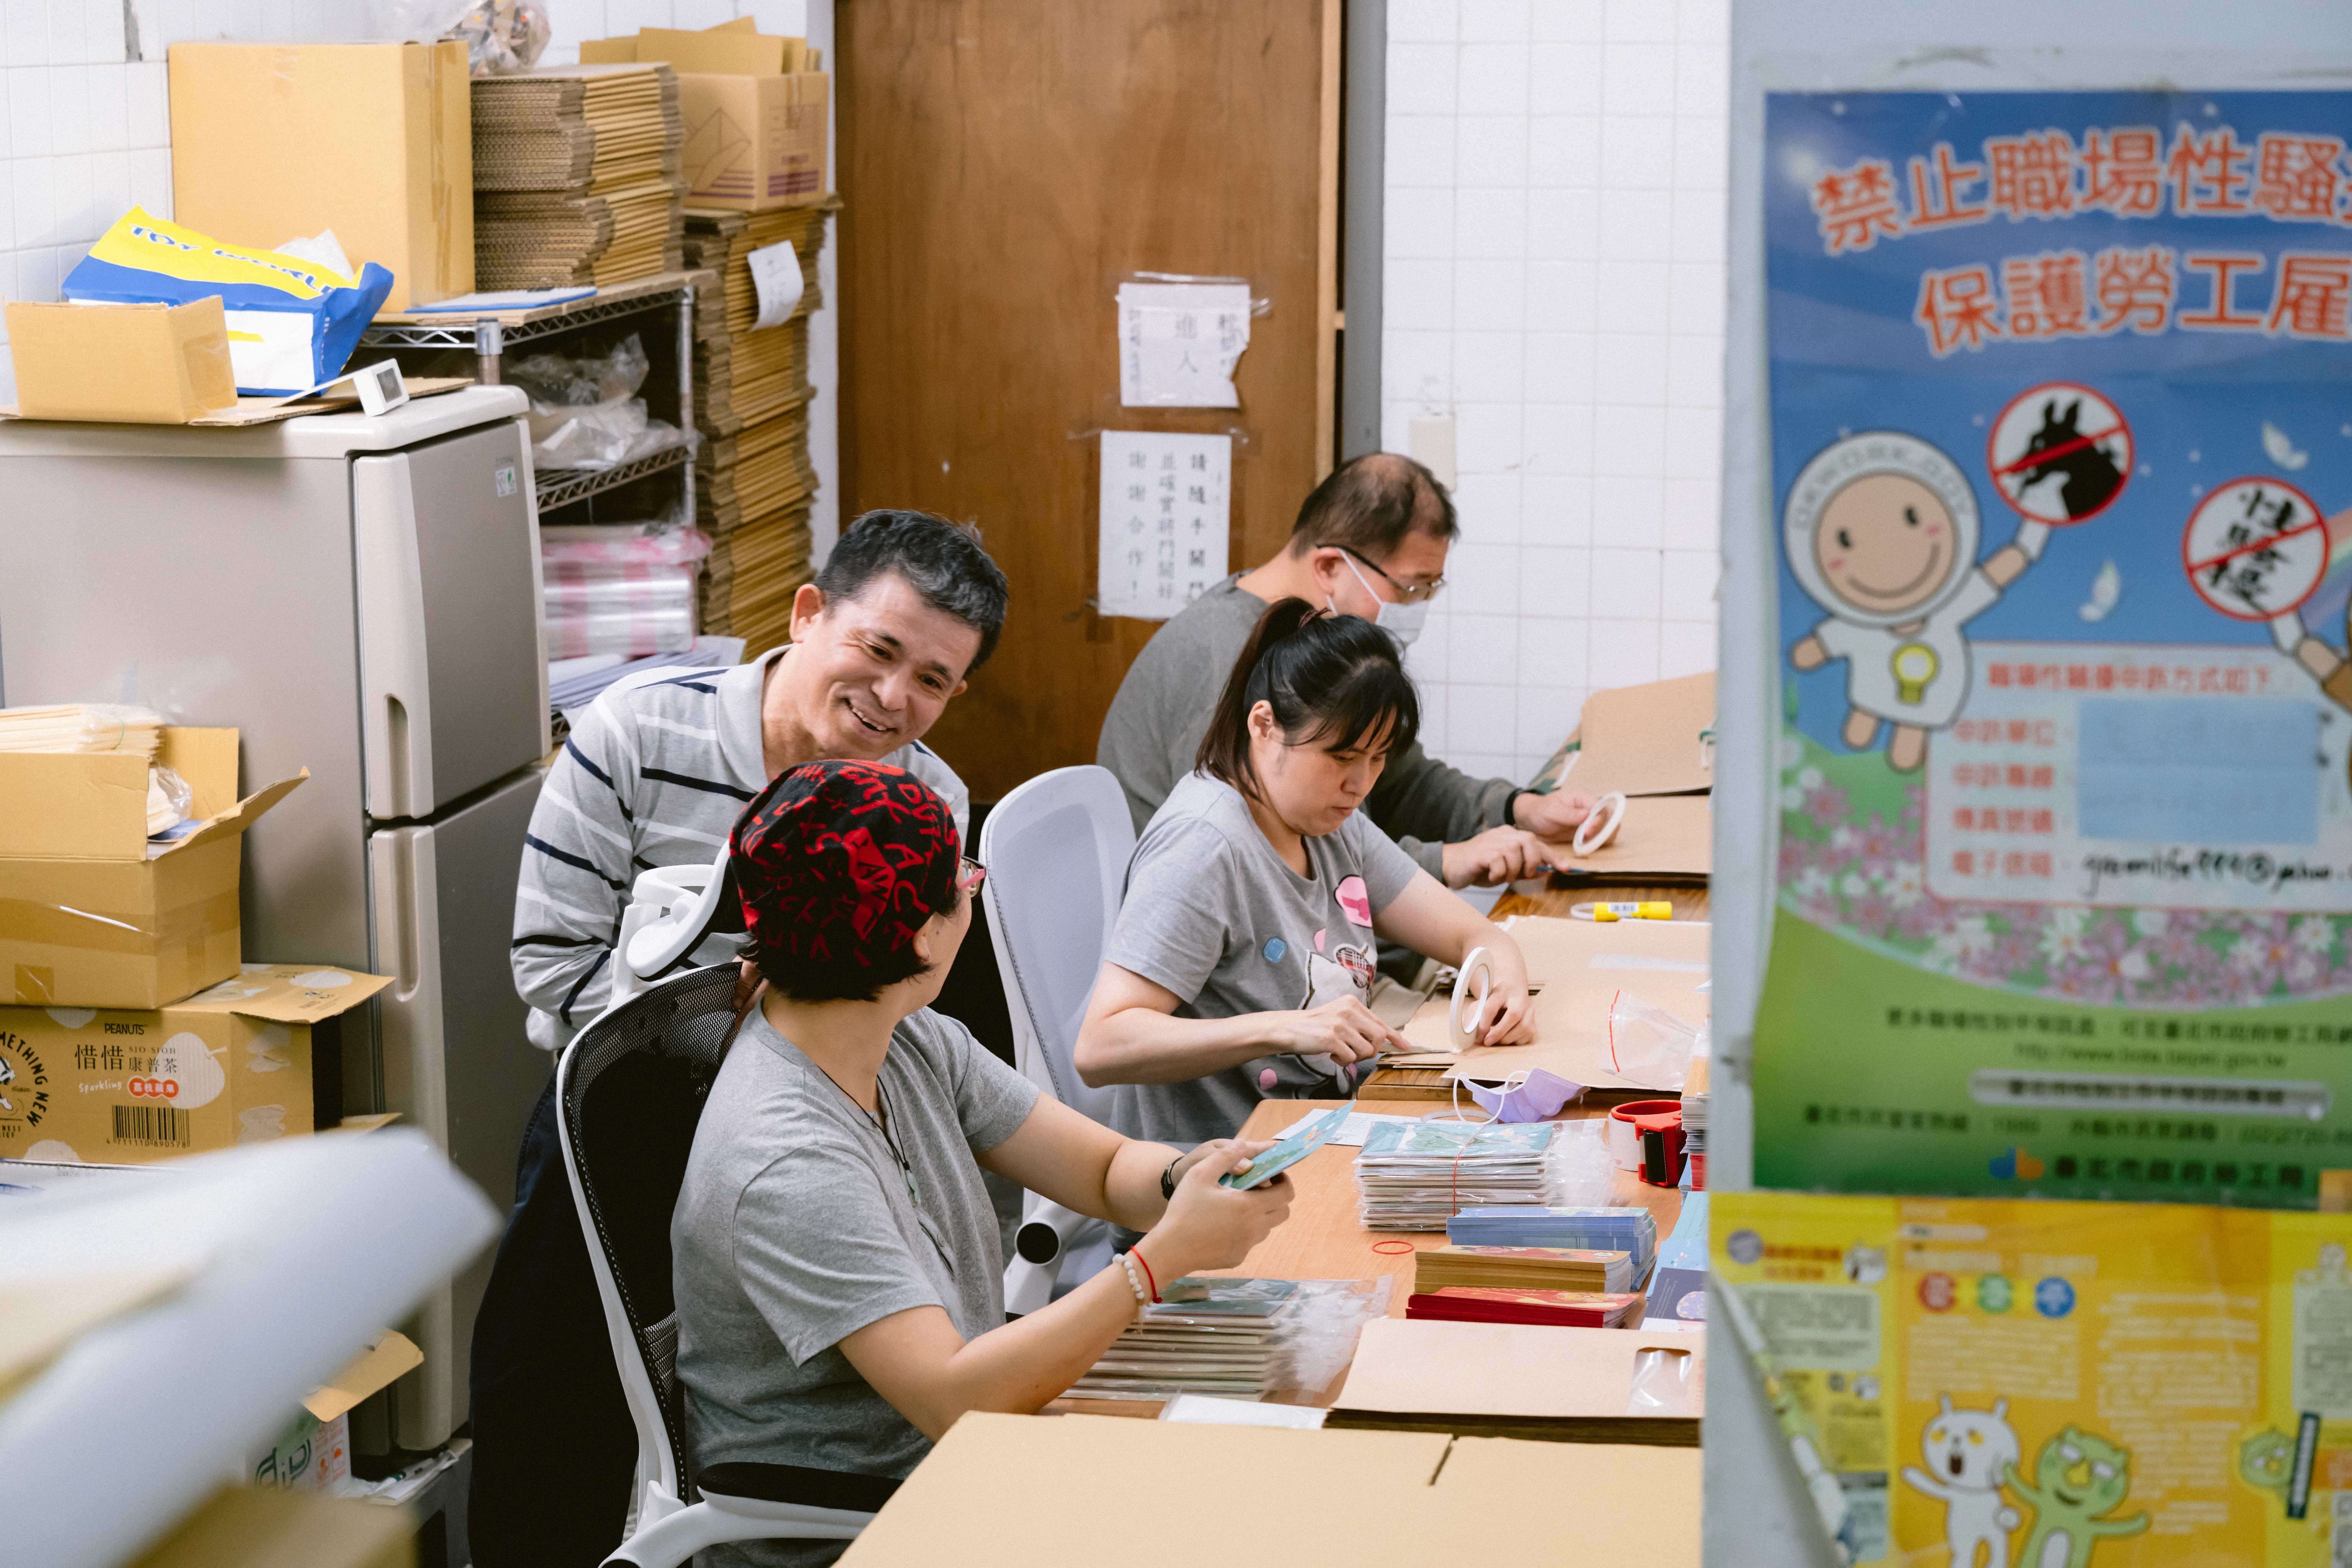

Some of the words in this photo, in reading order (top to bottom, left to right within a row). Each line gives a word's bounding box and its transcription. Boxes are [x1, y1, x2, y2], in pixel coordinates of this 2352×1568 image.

[1814, 130, 2352, 252] 禁止職場性騷
[129, 223, 202, 251] TOY
[105, 1023, 145, 1035] PEANUTS
[75, 1045, 124, 1070] 惜惜
[129, 1057, 177, 1073] 康普茶
[78, 1079, 122, 1094] Sparkling
[26, 1091, 49, 1127] NEW
[154, 1140, 186, 1148] 890578
